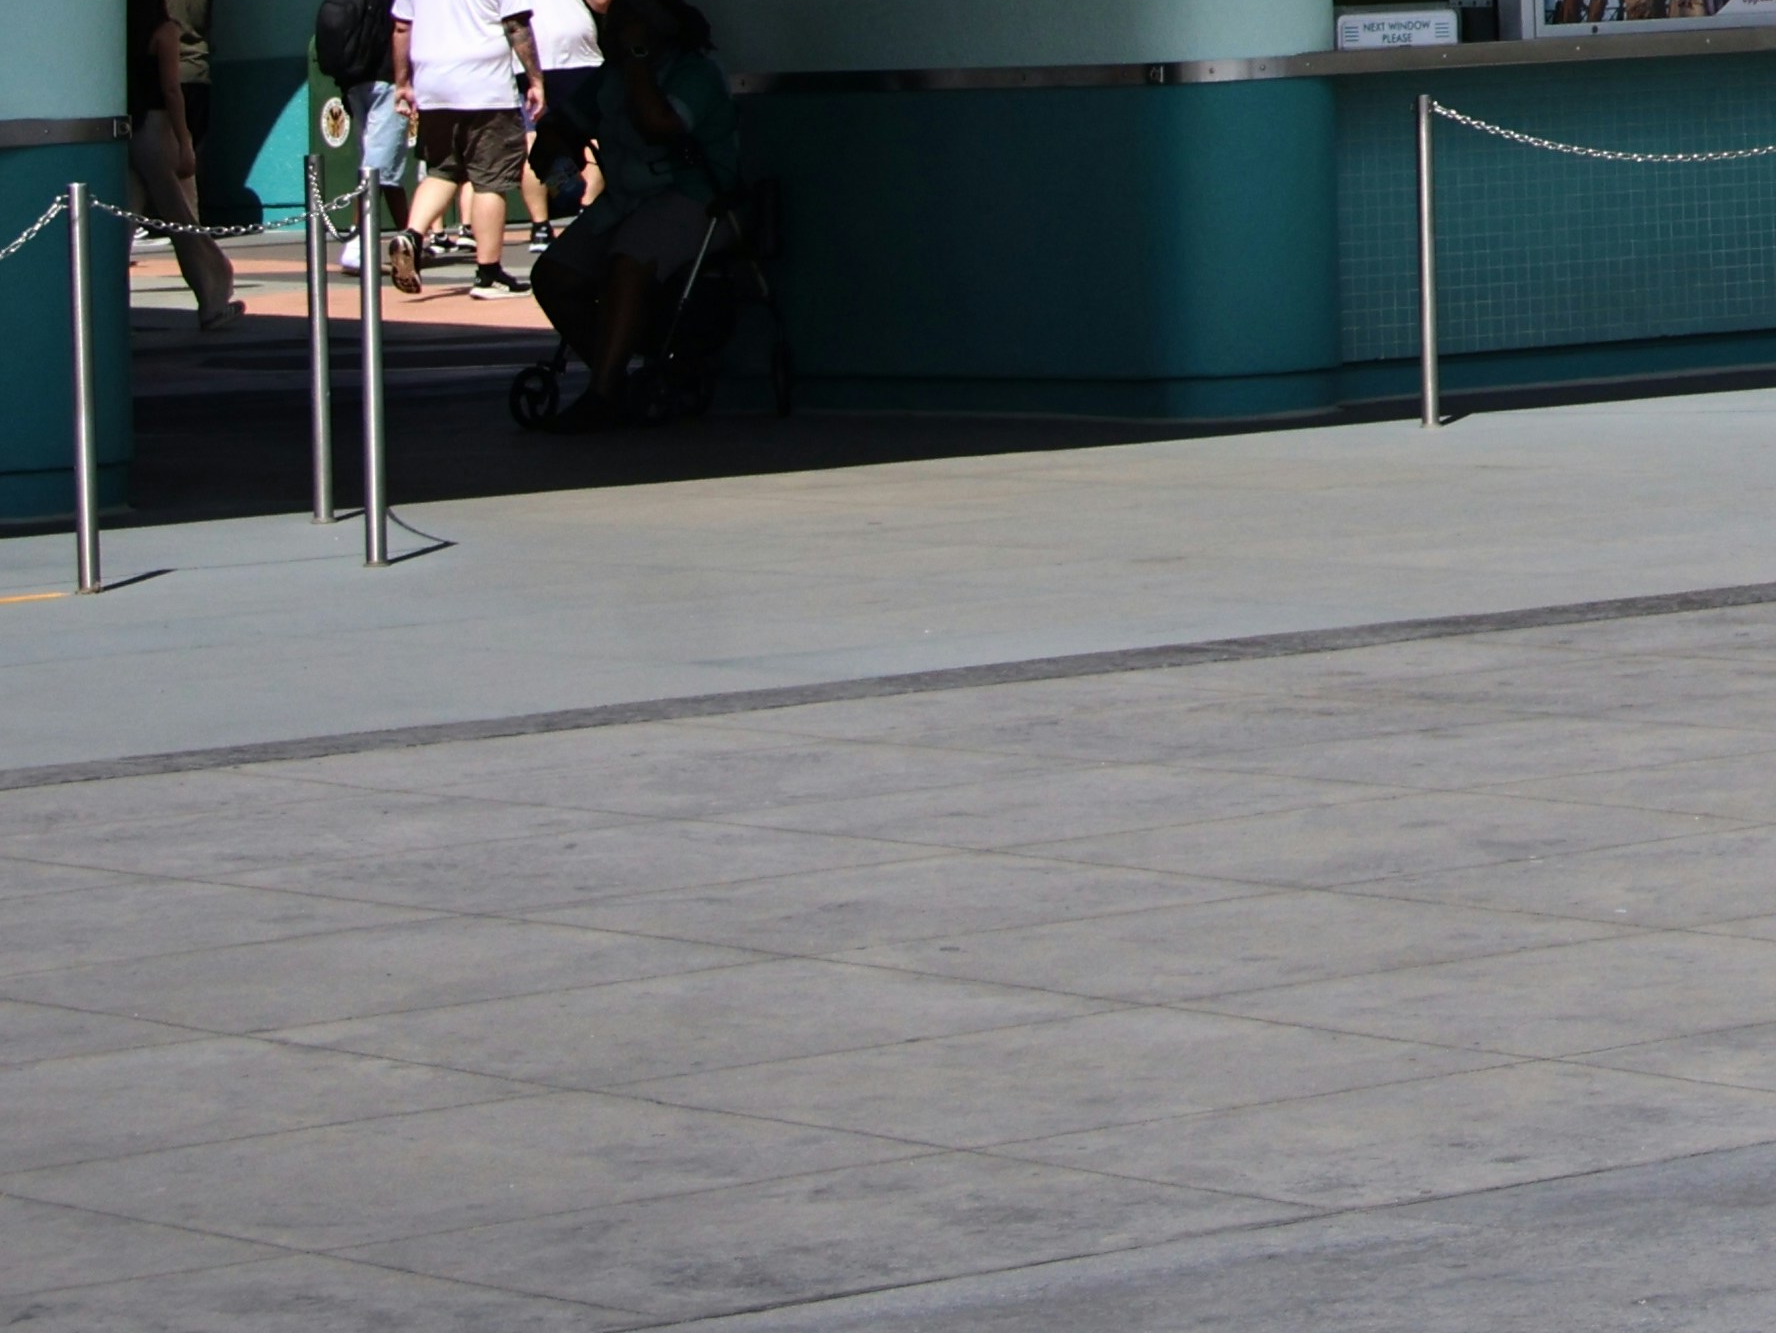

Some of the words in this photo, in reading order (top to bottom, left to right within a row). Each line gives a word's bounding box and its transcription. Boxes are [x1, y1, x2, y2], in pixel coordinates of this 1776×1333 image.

[1363, 22, 1385, 32] NEXT
[1388, 20, 1431, 30] WINDOW
[1382, 33, 1412, 43] PLEASE
